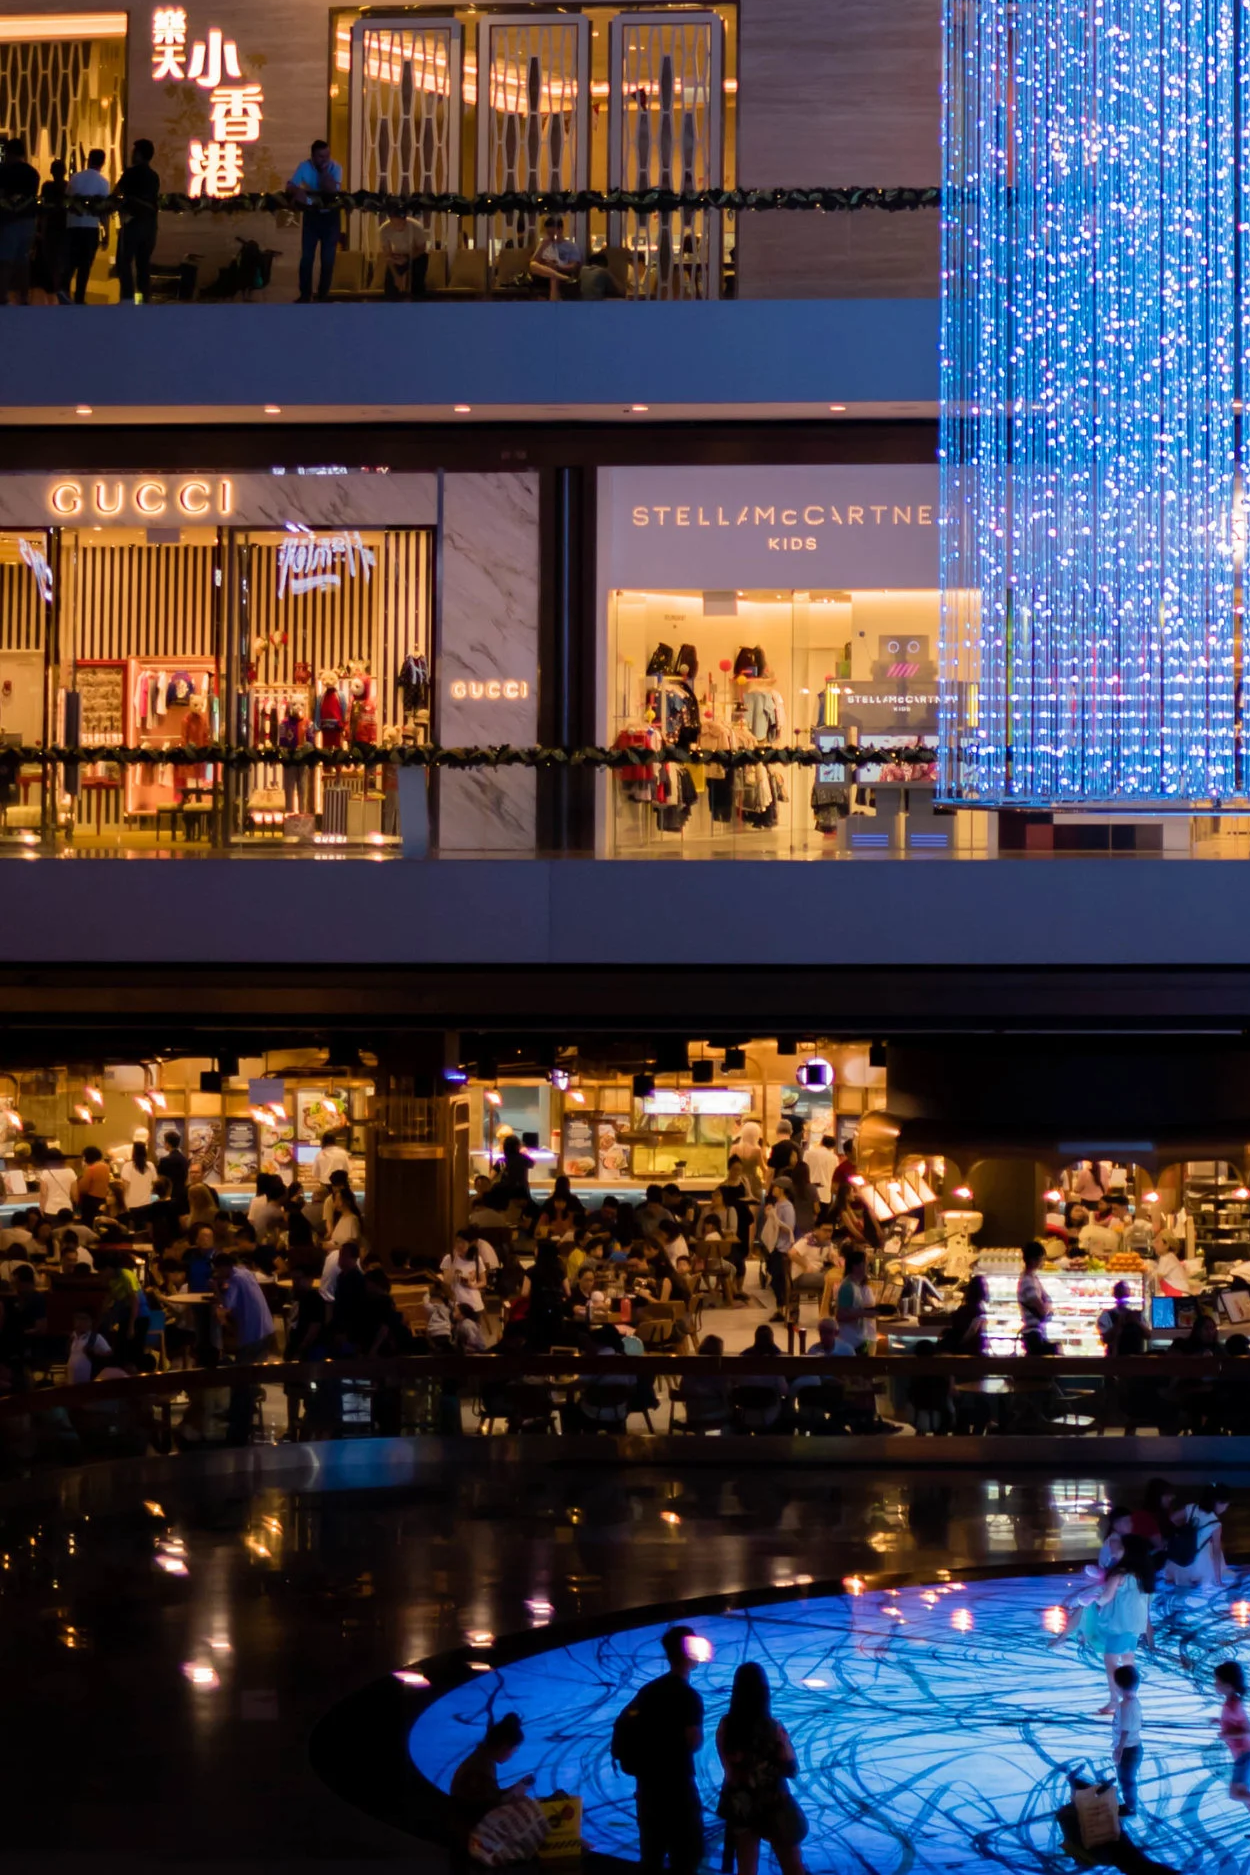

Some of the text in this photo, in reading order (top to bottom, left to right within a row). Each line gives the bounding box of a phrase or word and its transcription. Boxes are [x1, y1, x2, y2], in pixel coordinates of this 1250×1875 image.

[51, 480, 234, 515] GUCCI
[768, 537, 818, 551] KIDS
[450, 679, 529, 700] GUCCI
